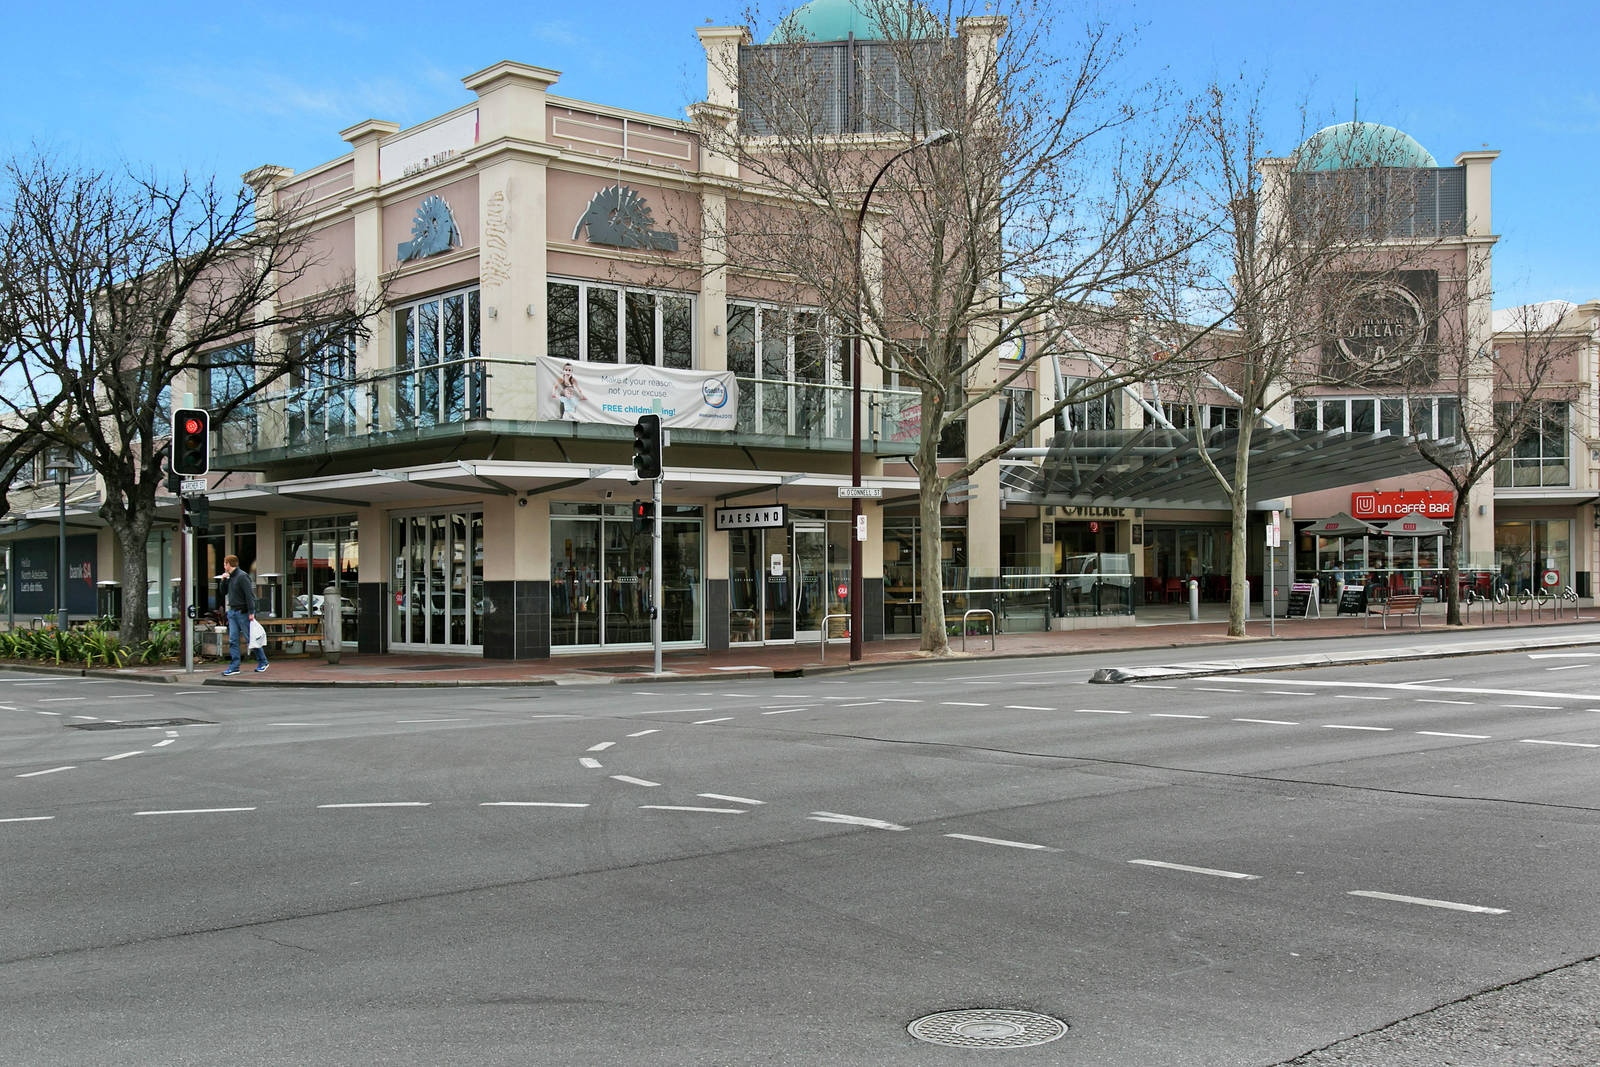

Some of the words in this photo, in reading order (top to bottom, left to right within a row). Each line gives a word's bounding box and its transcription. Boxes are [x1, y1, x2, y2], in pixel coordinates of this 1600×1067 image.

[601, 375, 621, 384] Make
[622, 376, 628, 384] it
[629, 378, 645, 386] your
[608, 387, 620, 395] not
[602, 404, 623, 413] FREE
[624, 405, 676, 417] childmiing!
[1077, 506, 1125, 517] VILLAGE
[720, 511, 779, 524] PAESANO
